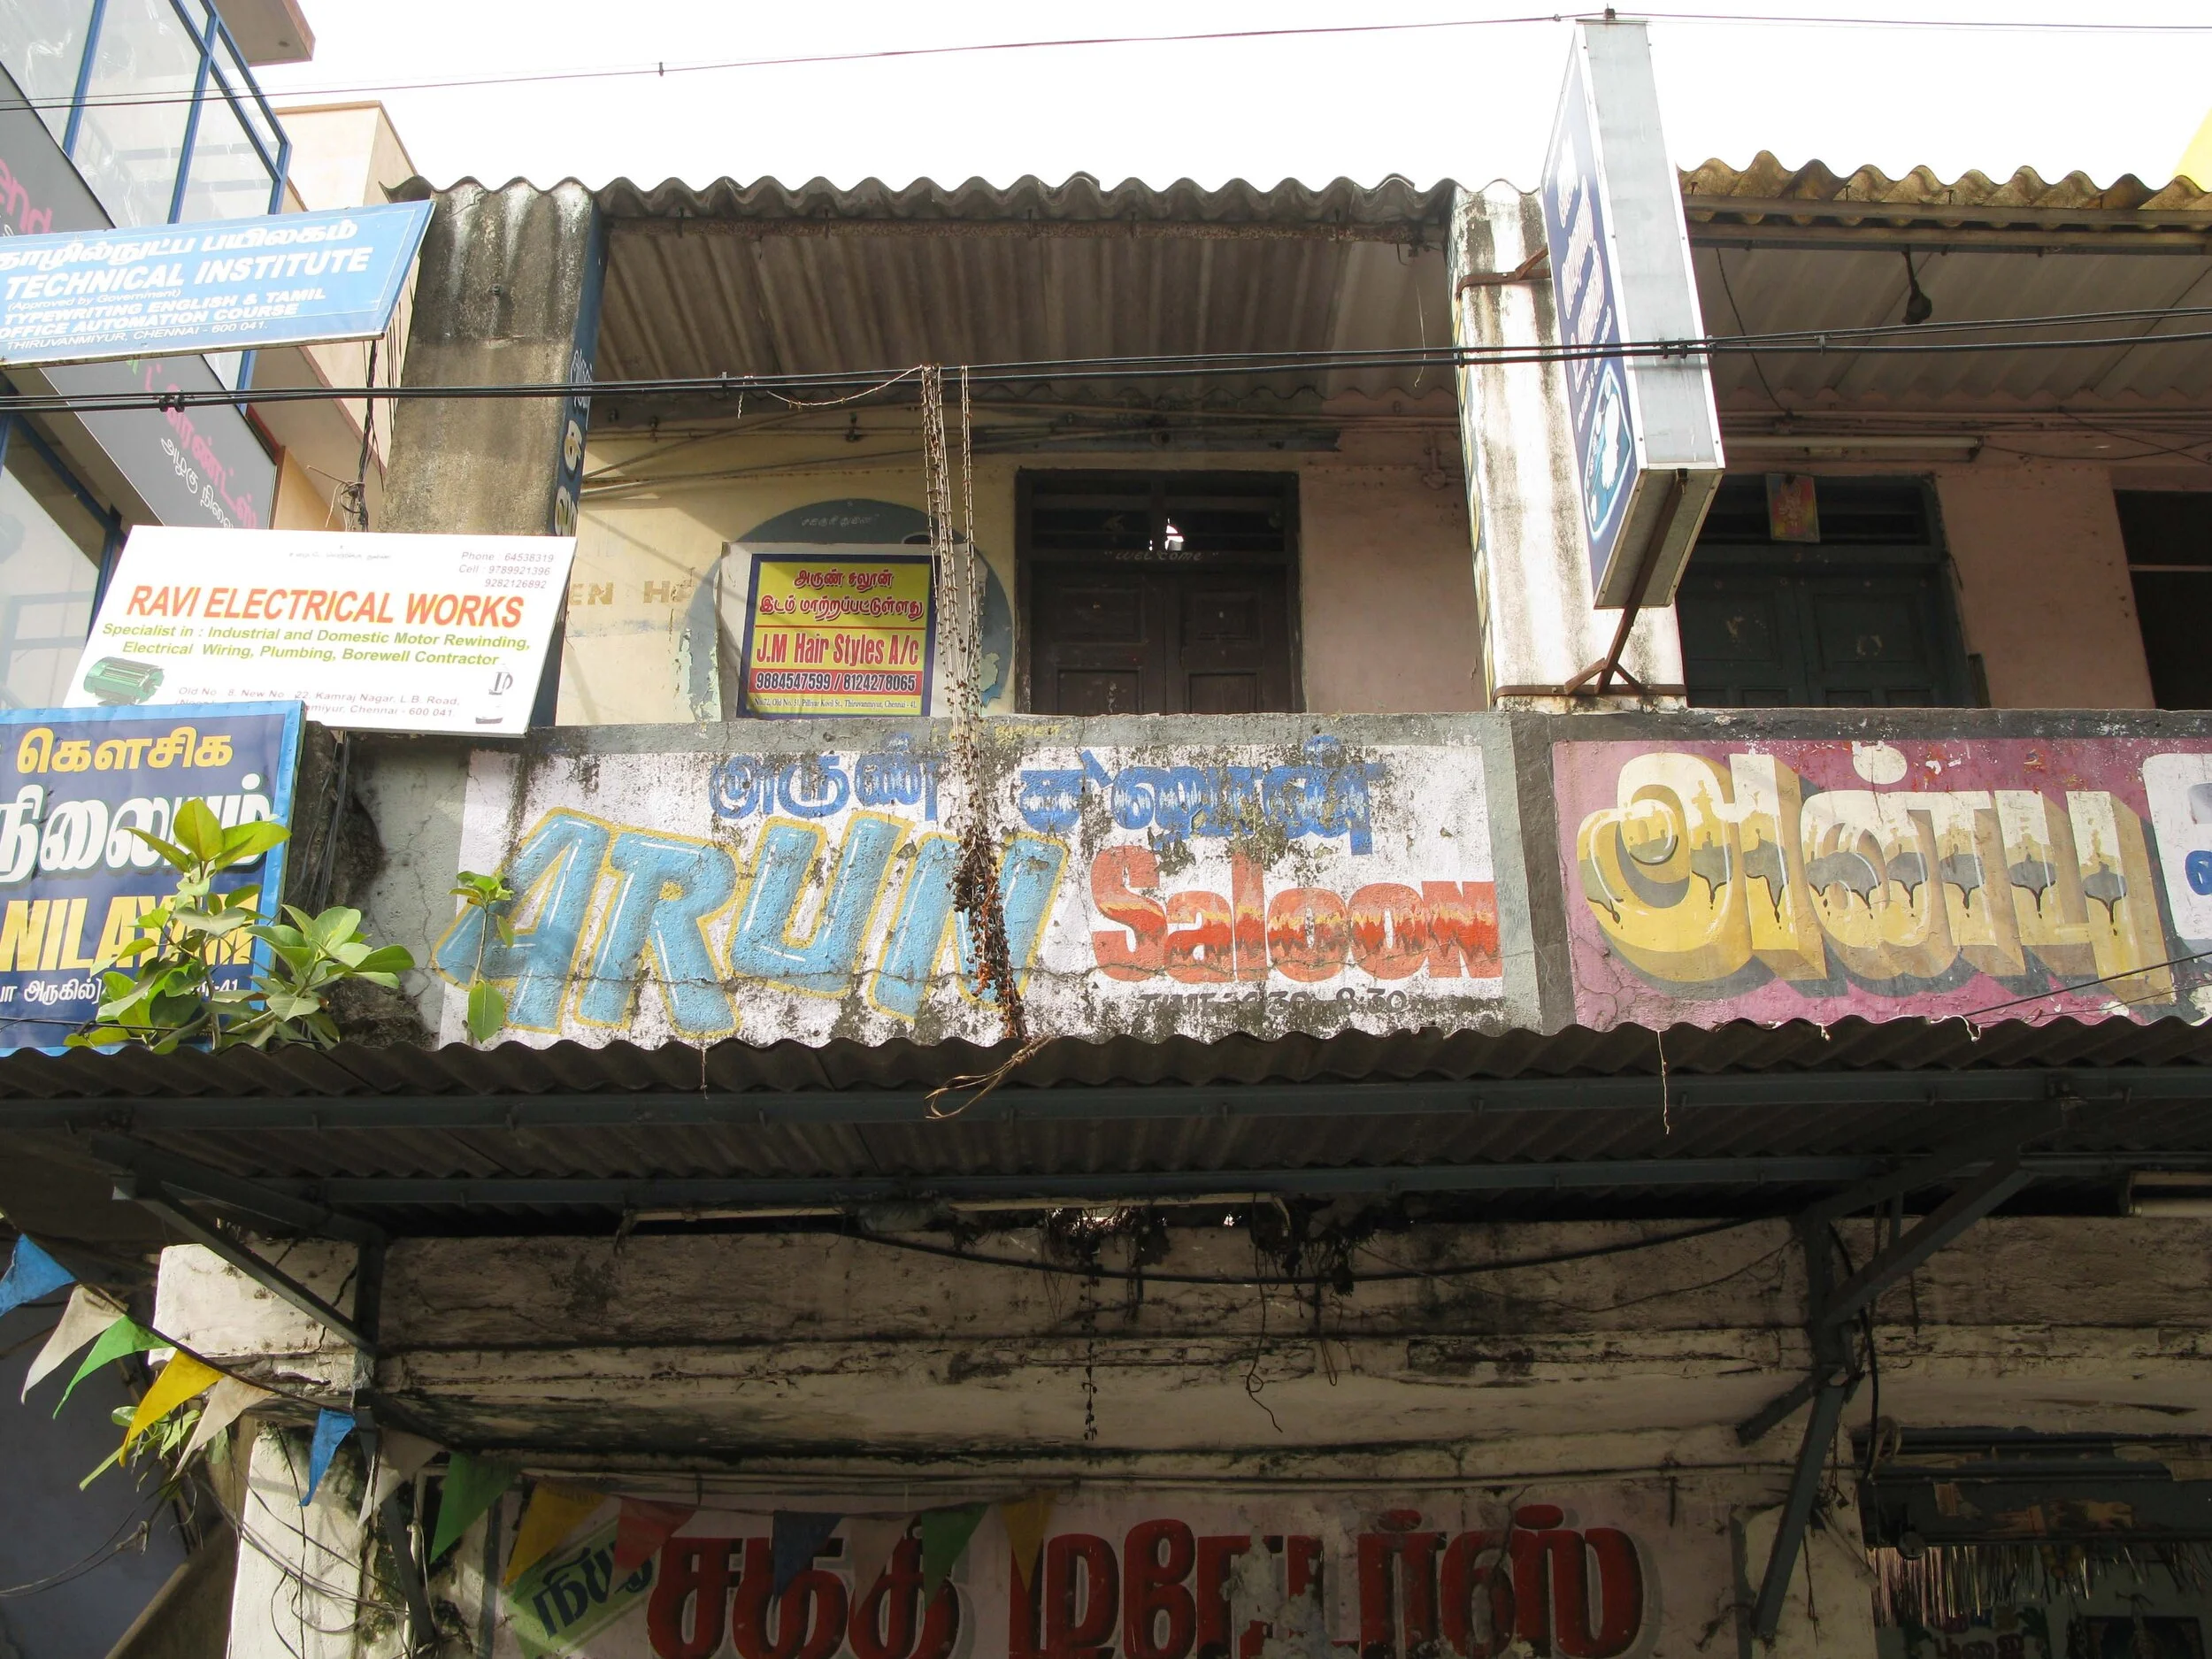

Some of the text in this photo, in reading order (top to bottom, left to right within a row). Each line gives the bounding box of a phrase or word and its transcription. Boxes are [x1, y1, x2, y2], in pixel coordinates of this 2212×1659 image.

[5, 247, 374, 300] TECHNICAL INSTITUTE
[4, 288, 326, 326] TYPEWRITING ENGLISH & TAMIL
[7, 297, 76, 311] (Approved
[78, 295, 95, 306] by
[0, 303, 300, 340] OFFICE AUTOMATION COURSE
[7, 331, 129, 351] THIRUVANMIYUR,
[133, 326, 200, 342] CHENNAI
[211, 321, 238, 334] 600
[458, 564, 480, 573] Cell
[461, 551, 495, 561] Phone
[794, 568, 895, 593] அருண் சலூன்
[127, 585, 525, 628] RAVI ELECTRICAL WORKS
[759, 594, 797, 614] இடம்
[103, 622, 177, 639] Specialist
[180, 625, 193, 637] in
[208, 626, 280, 641] Industrial
[284, 629, 313, 641] and
[317, 629, 390, 644] Domestic
[394, 632, 441, 646] Motor
[443, 634, 531, 650] Rewinding,
[122, 641, 500, 665] Electrical Wiring, Plumbing, Borewell Contractor
[756, 632, 920, 667] J.M Hair Styles A/c
[755, 671, 832, 691] 9884547599
[843, 672, 917, 693] 8124278065
[179, 687, 198, 697] Old
[241, 689, 264, 698] New
[315, 691, 357, 703] Kamraj
[349, 704, 398, 716] Chennai
[409, 707, 429, 717] 600
[433, 807, 1069, 1039] ARUN
